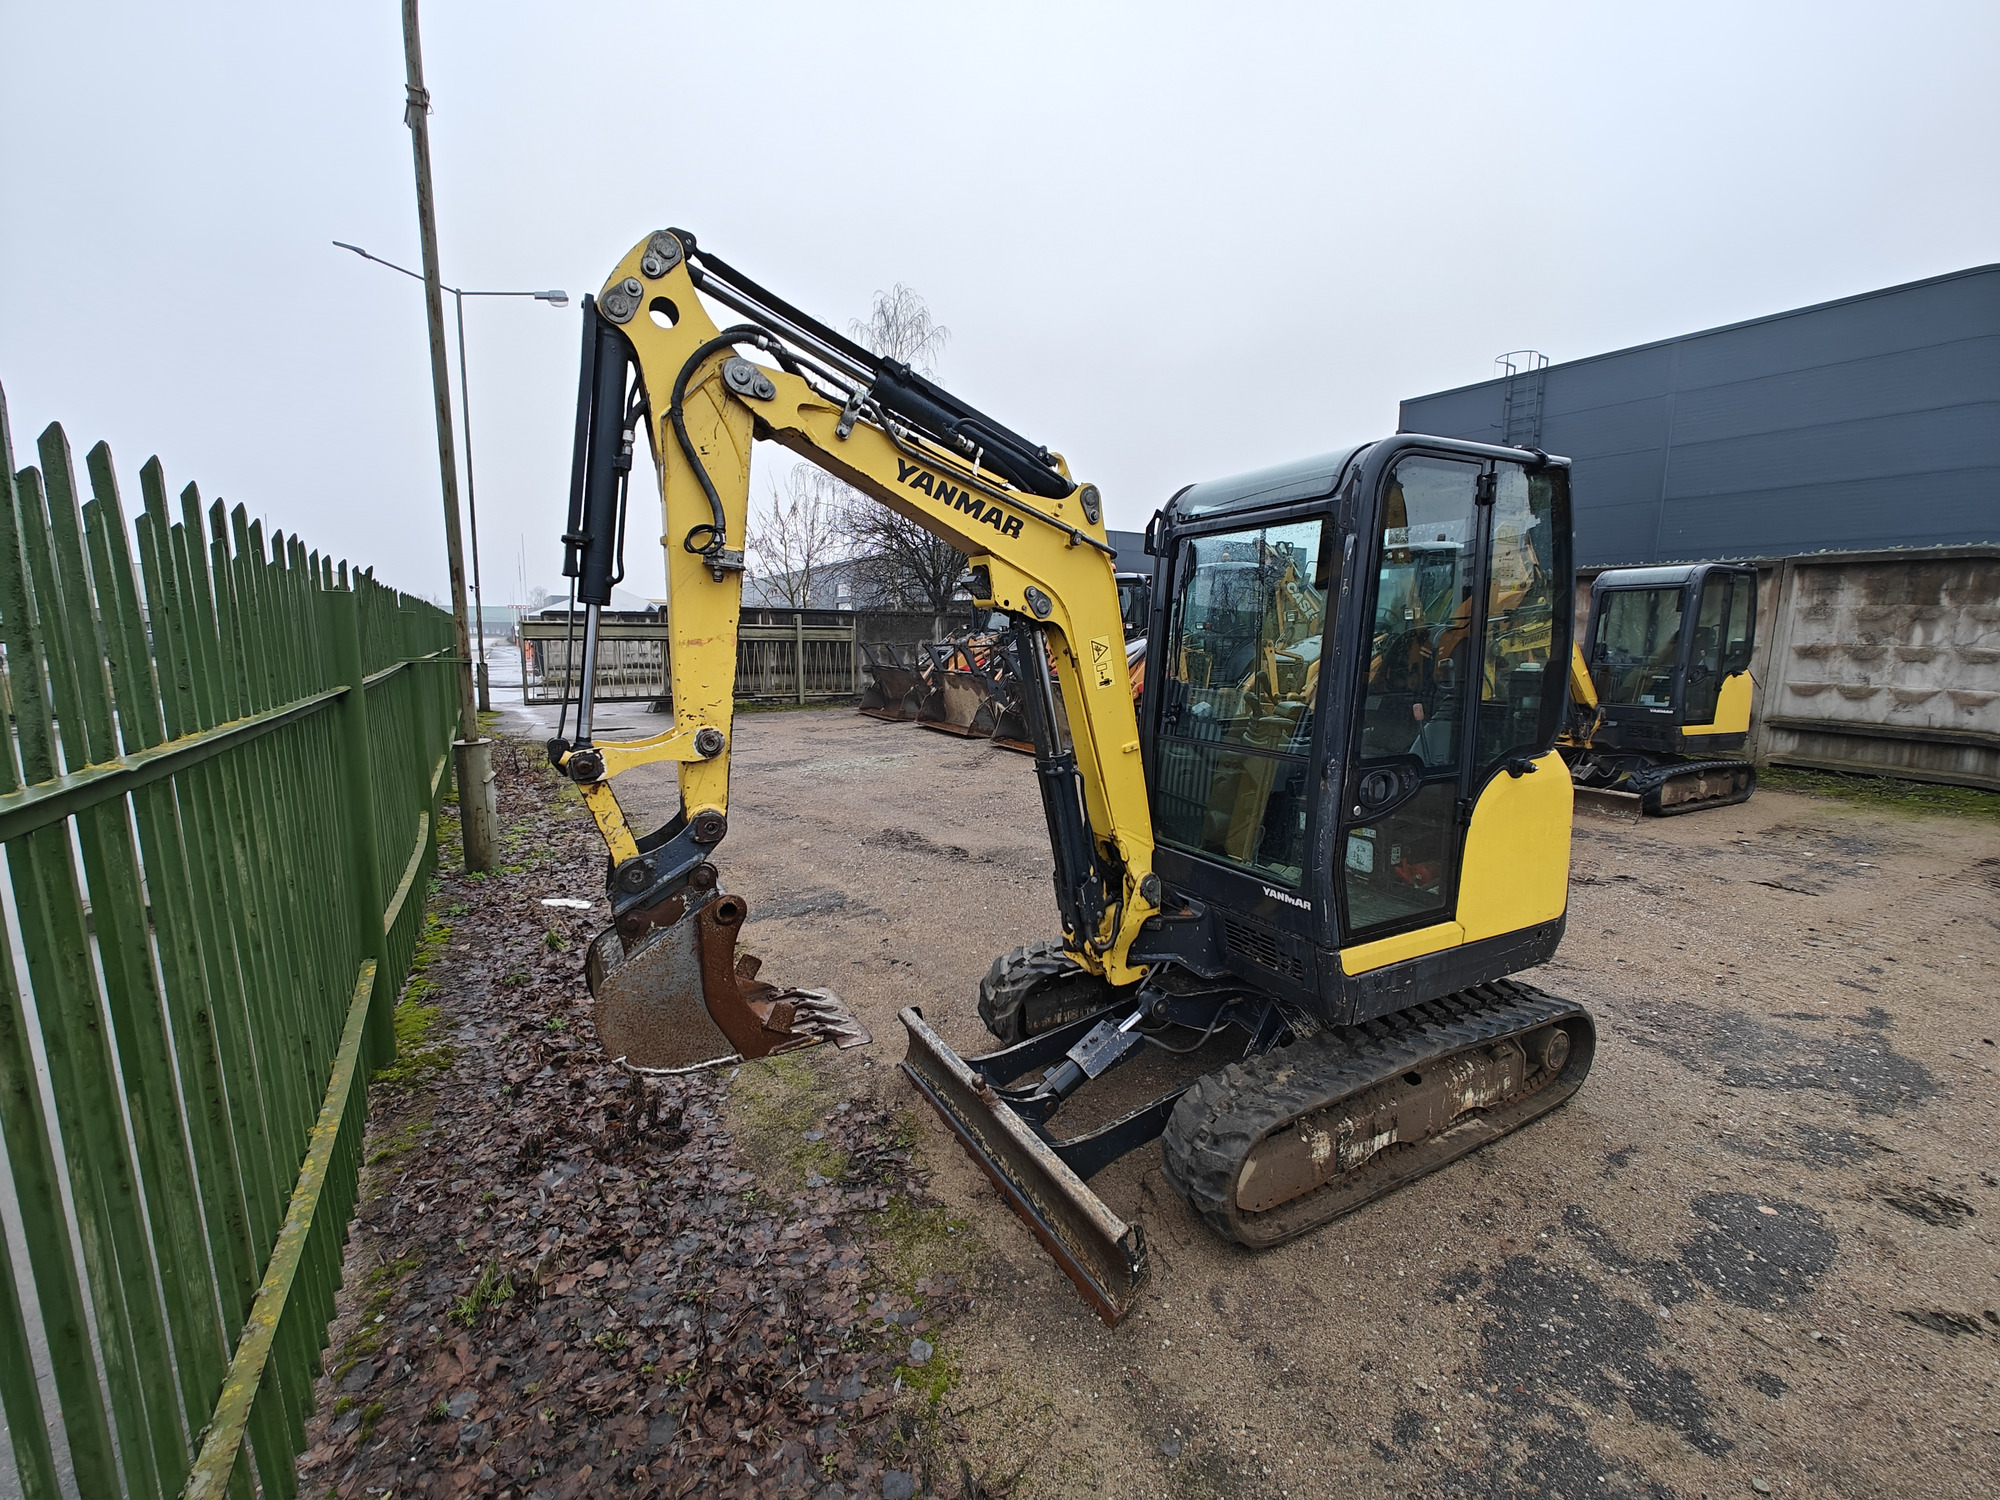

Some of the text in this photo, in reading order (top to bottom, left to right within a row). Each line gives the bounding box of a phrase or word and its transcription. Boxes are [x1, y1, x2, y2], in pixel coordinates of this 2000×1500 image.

[897, 458, 1024, 539] YANMAR
[1287, 582, 1318, 621] CASE
[1262, 886, 1312, 911] YANMAR
